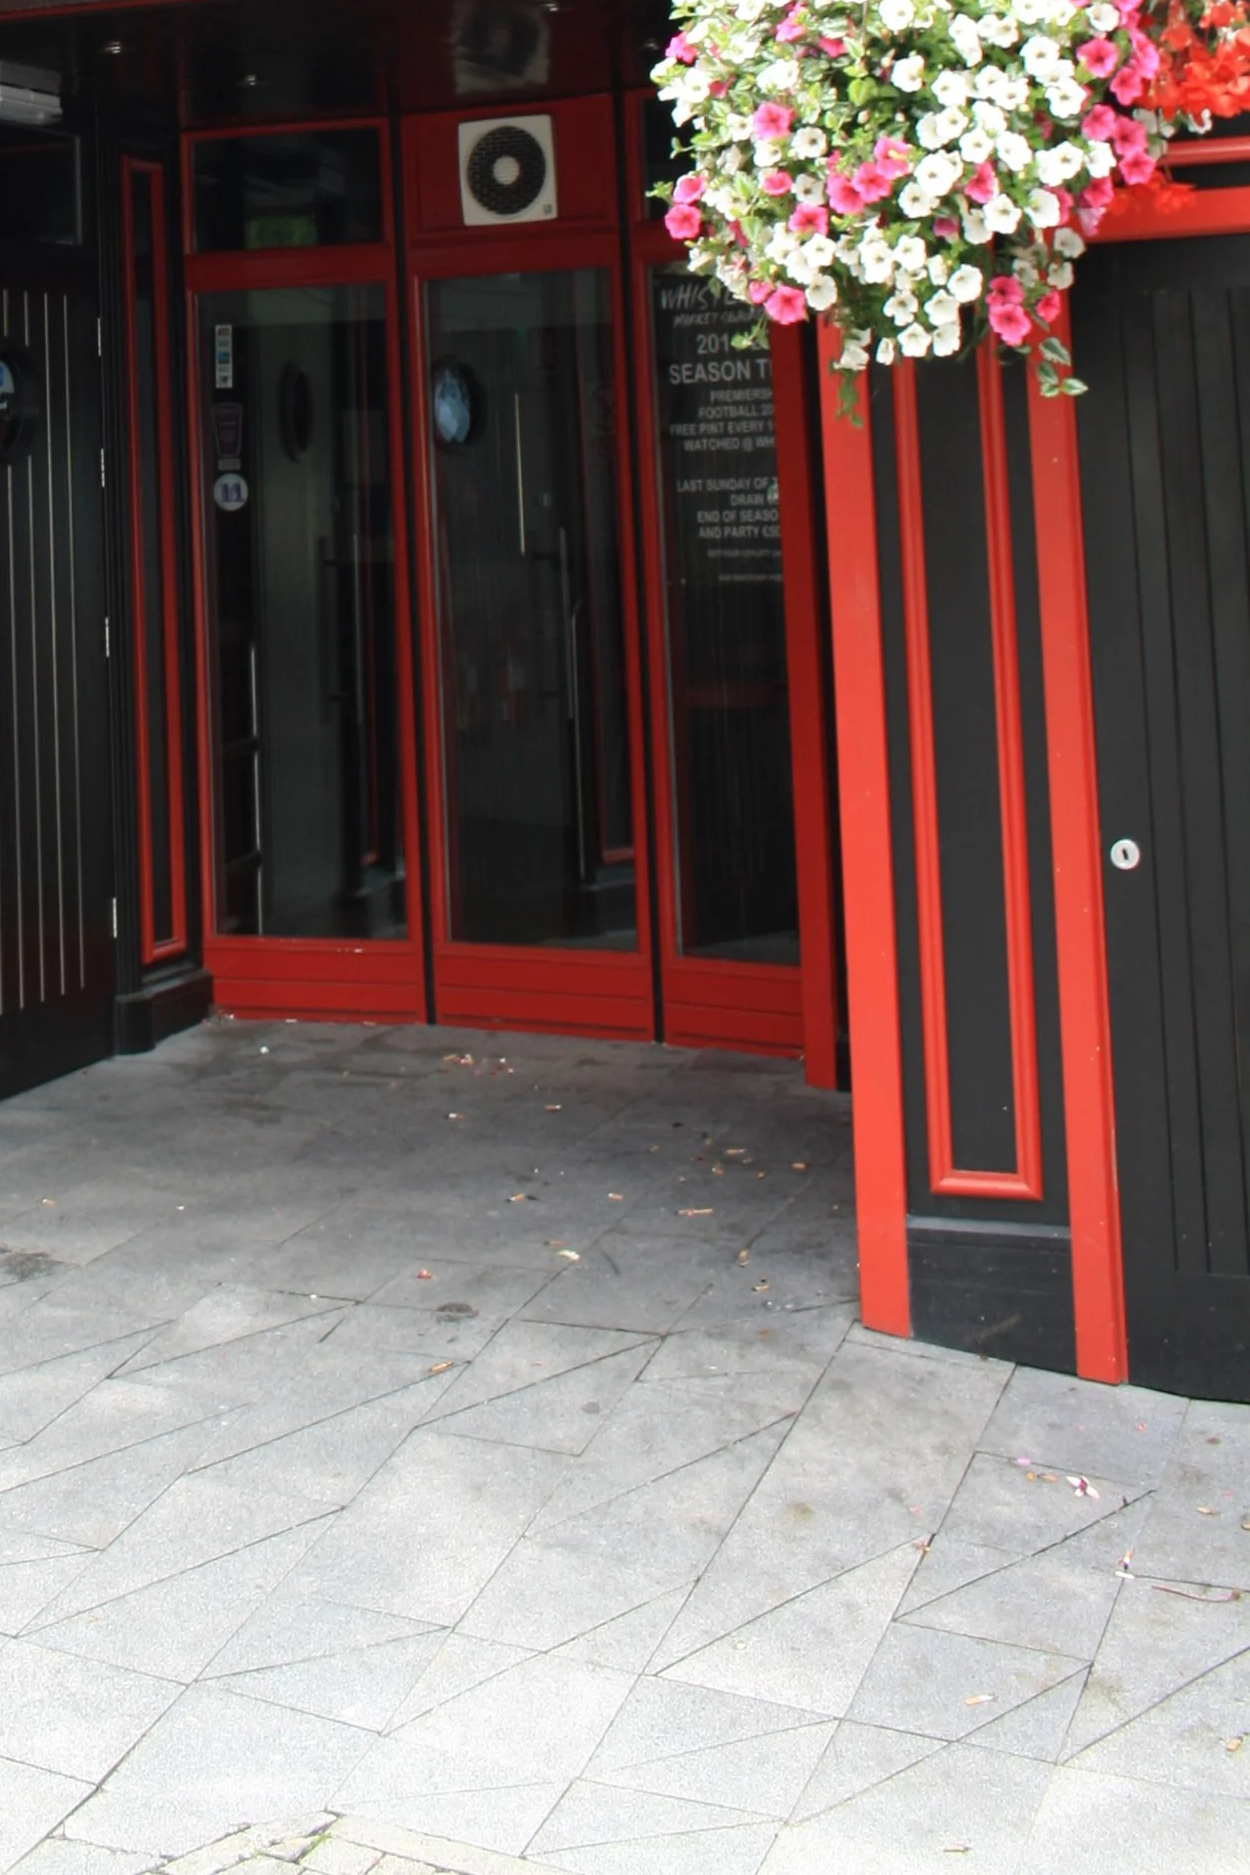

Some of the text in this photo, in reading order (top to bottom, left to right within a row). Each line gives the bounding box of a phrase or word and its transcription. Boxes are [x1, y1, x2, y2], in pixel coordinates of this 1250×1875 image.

[669, 358, 771, 385] SEASON T
[698, 404, 759, 420] FOOTBALL
[670, 423, 697, 436] FREE
[699, 421, 725, 435] PINT
[727, 419, 765, 434] EVERY
[683, 437, 740, 452] WATCHED
[677, 478, 703, 493] LAST
[706, 477, 751, 492] SUNDAY
[753, 476, 769, 490] OF
[730, 493, 765, 507] DRAW
[697, 510, 720, 524] END
[722, 509, 737, 523] OF
[698, 525, 722, 539] AND
[723, 525, 760, 539] PARTY
